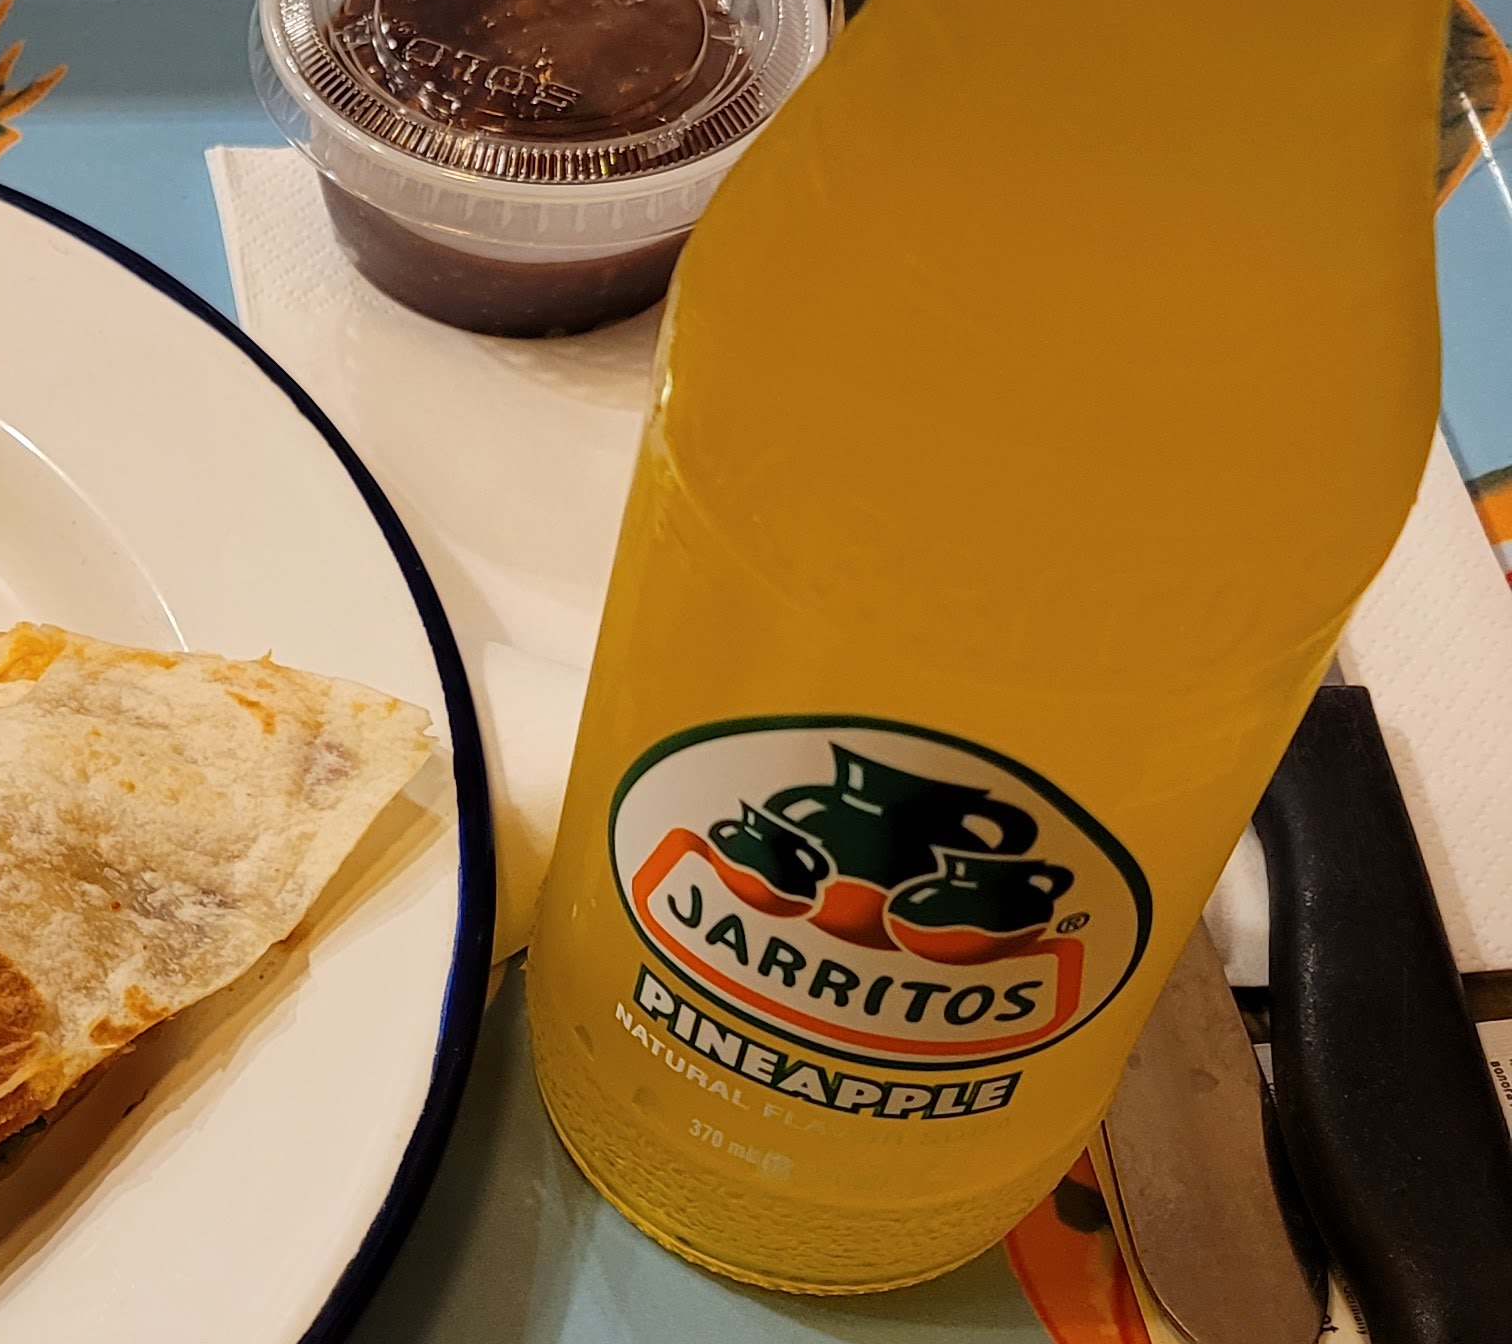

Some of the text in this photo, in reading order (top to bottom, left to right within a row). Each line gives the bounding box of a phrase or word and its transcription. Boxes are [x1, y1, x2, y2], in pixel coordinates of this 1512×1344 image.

[667, 885, 1044, 1026] JARRITOS
[615, 1002, 749, 1111] NATURAL
[635, 965, 1022, 1119] PINEAPPLE
[688, 1118, 724, 1148] 370
